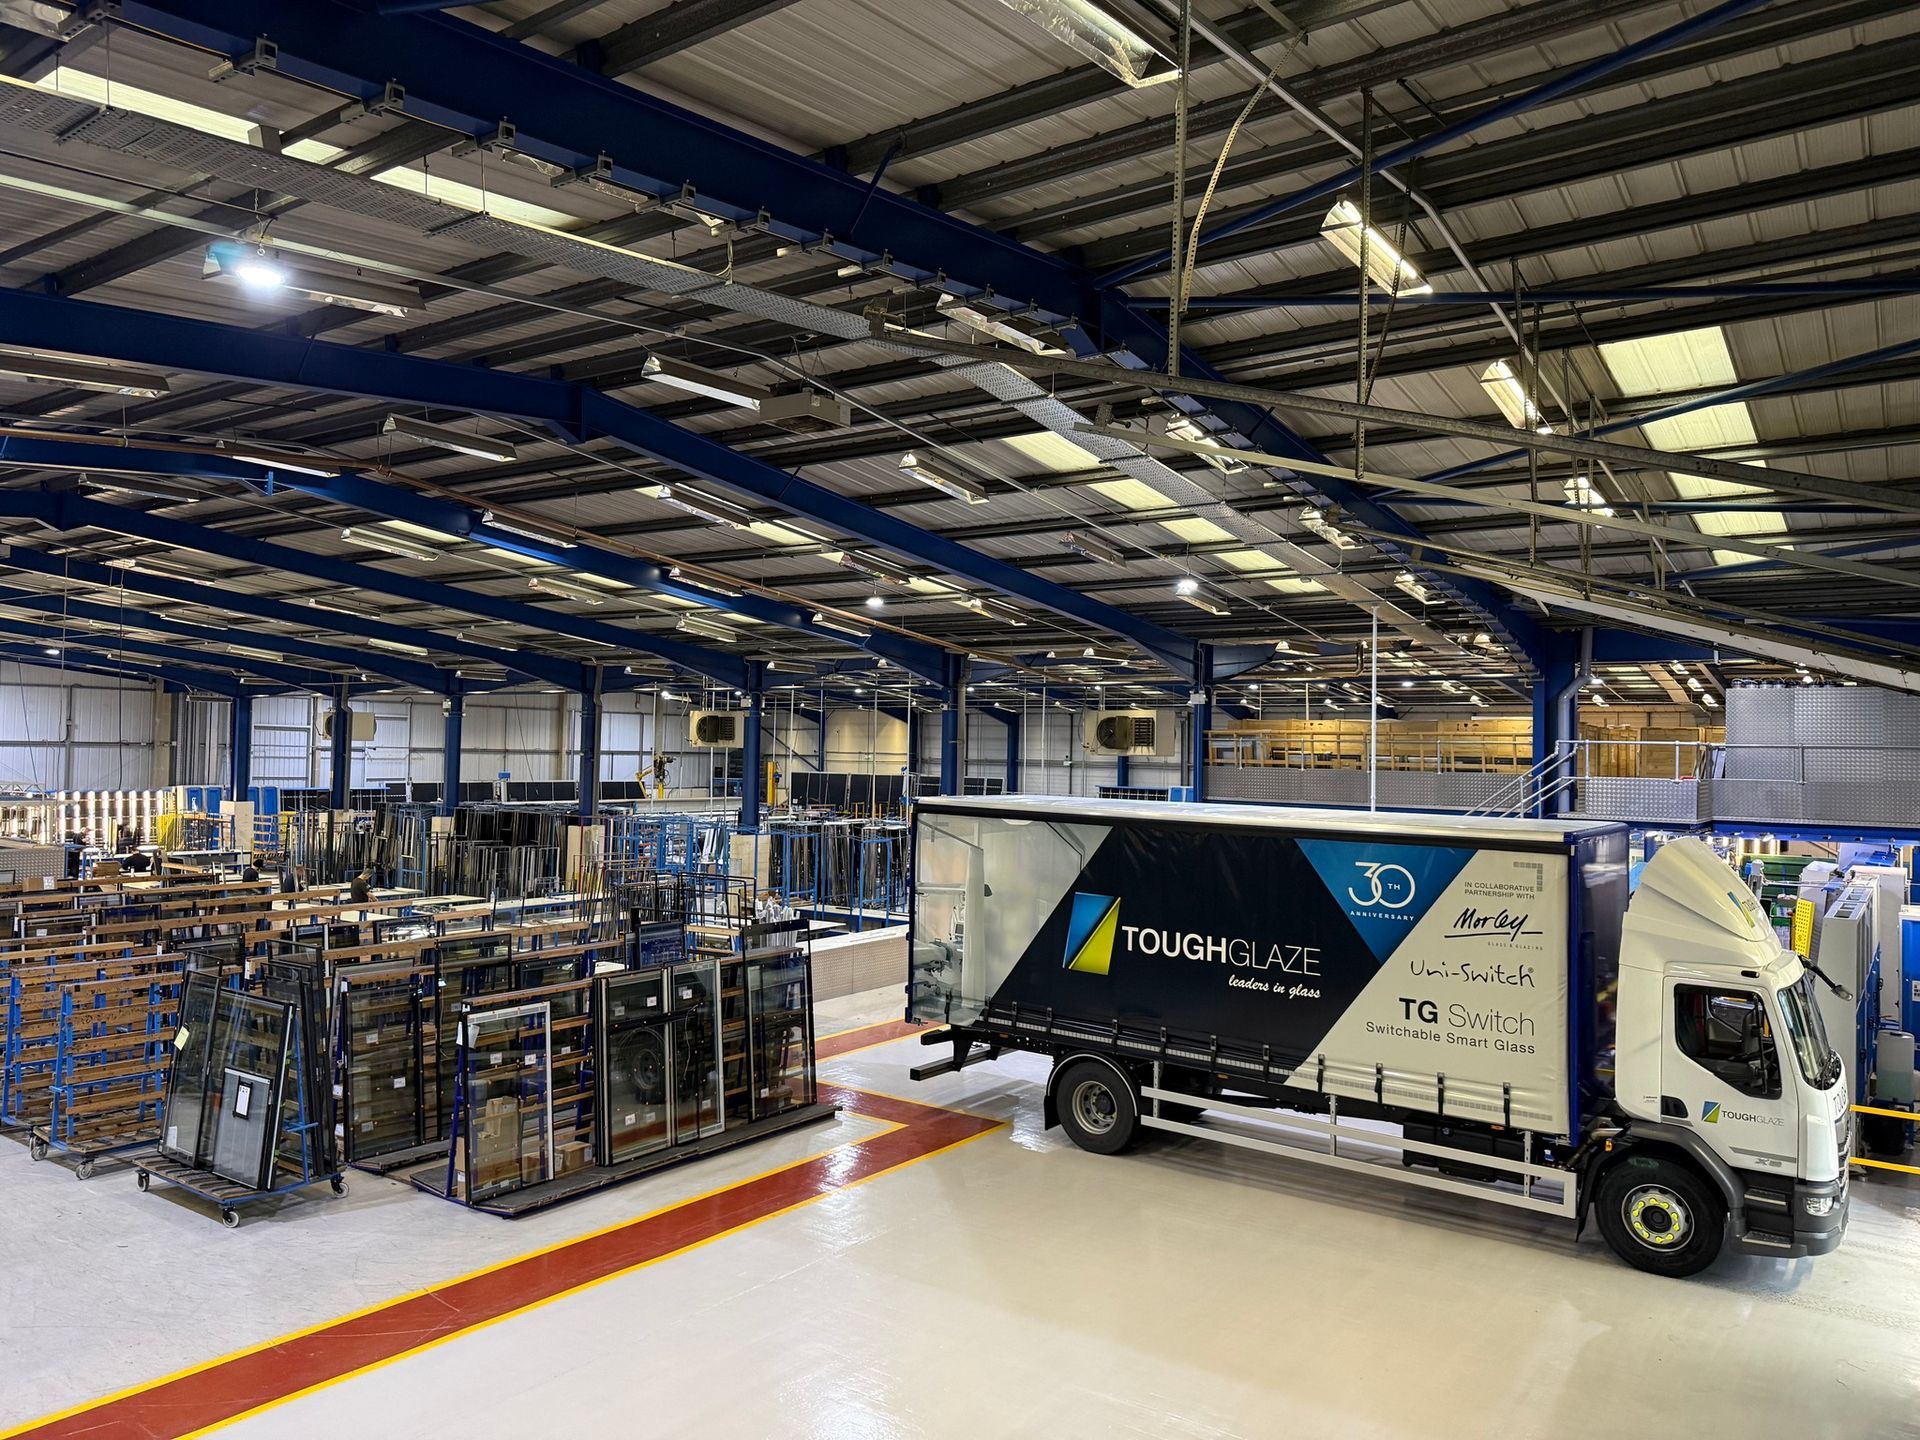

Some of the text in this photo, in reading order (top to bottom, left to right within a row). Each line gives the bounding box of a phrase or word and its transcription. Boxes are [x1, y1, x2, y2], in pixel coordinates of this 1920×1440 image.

[1348, 861, 1416, 909] 30
[1387, 883, 1401, 891] TH
[1464, 888, 1535, 900] PARTNERSHIP WITH
[1474, 882, 1535, 893] COLLABORATIVE
[1350, 910, 1415, 921] ANNIVERSARY
[1453, 907, 1529, 942] Morley
[1121, 925, 1321, 977] TOUGHGLAZE
[1228, 974, 1321, 999] leaders in glass
[1399, 997, 1535, 1037] TG Switch
[1366, 1021, 1535, 1054] Switchable Smart Glass
[1721, 1110, 1785, 1127] TOUGHGLAZE
